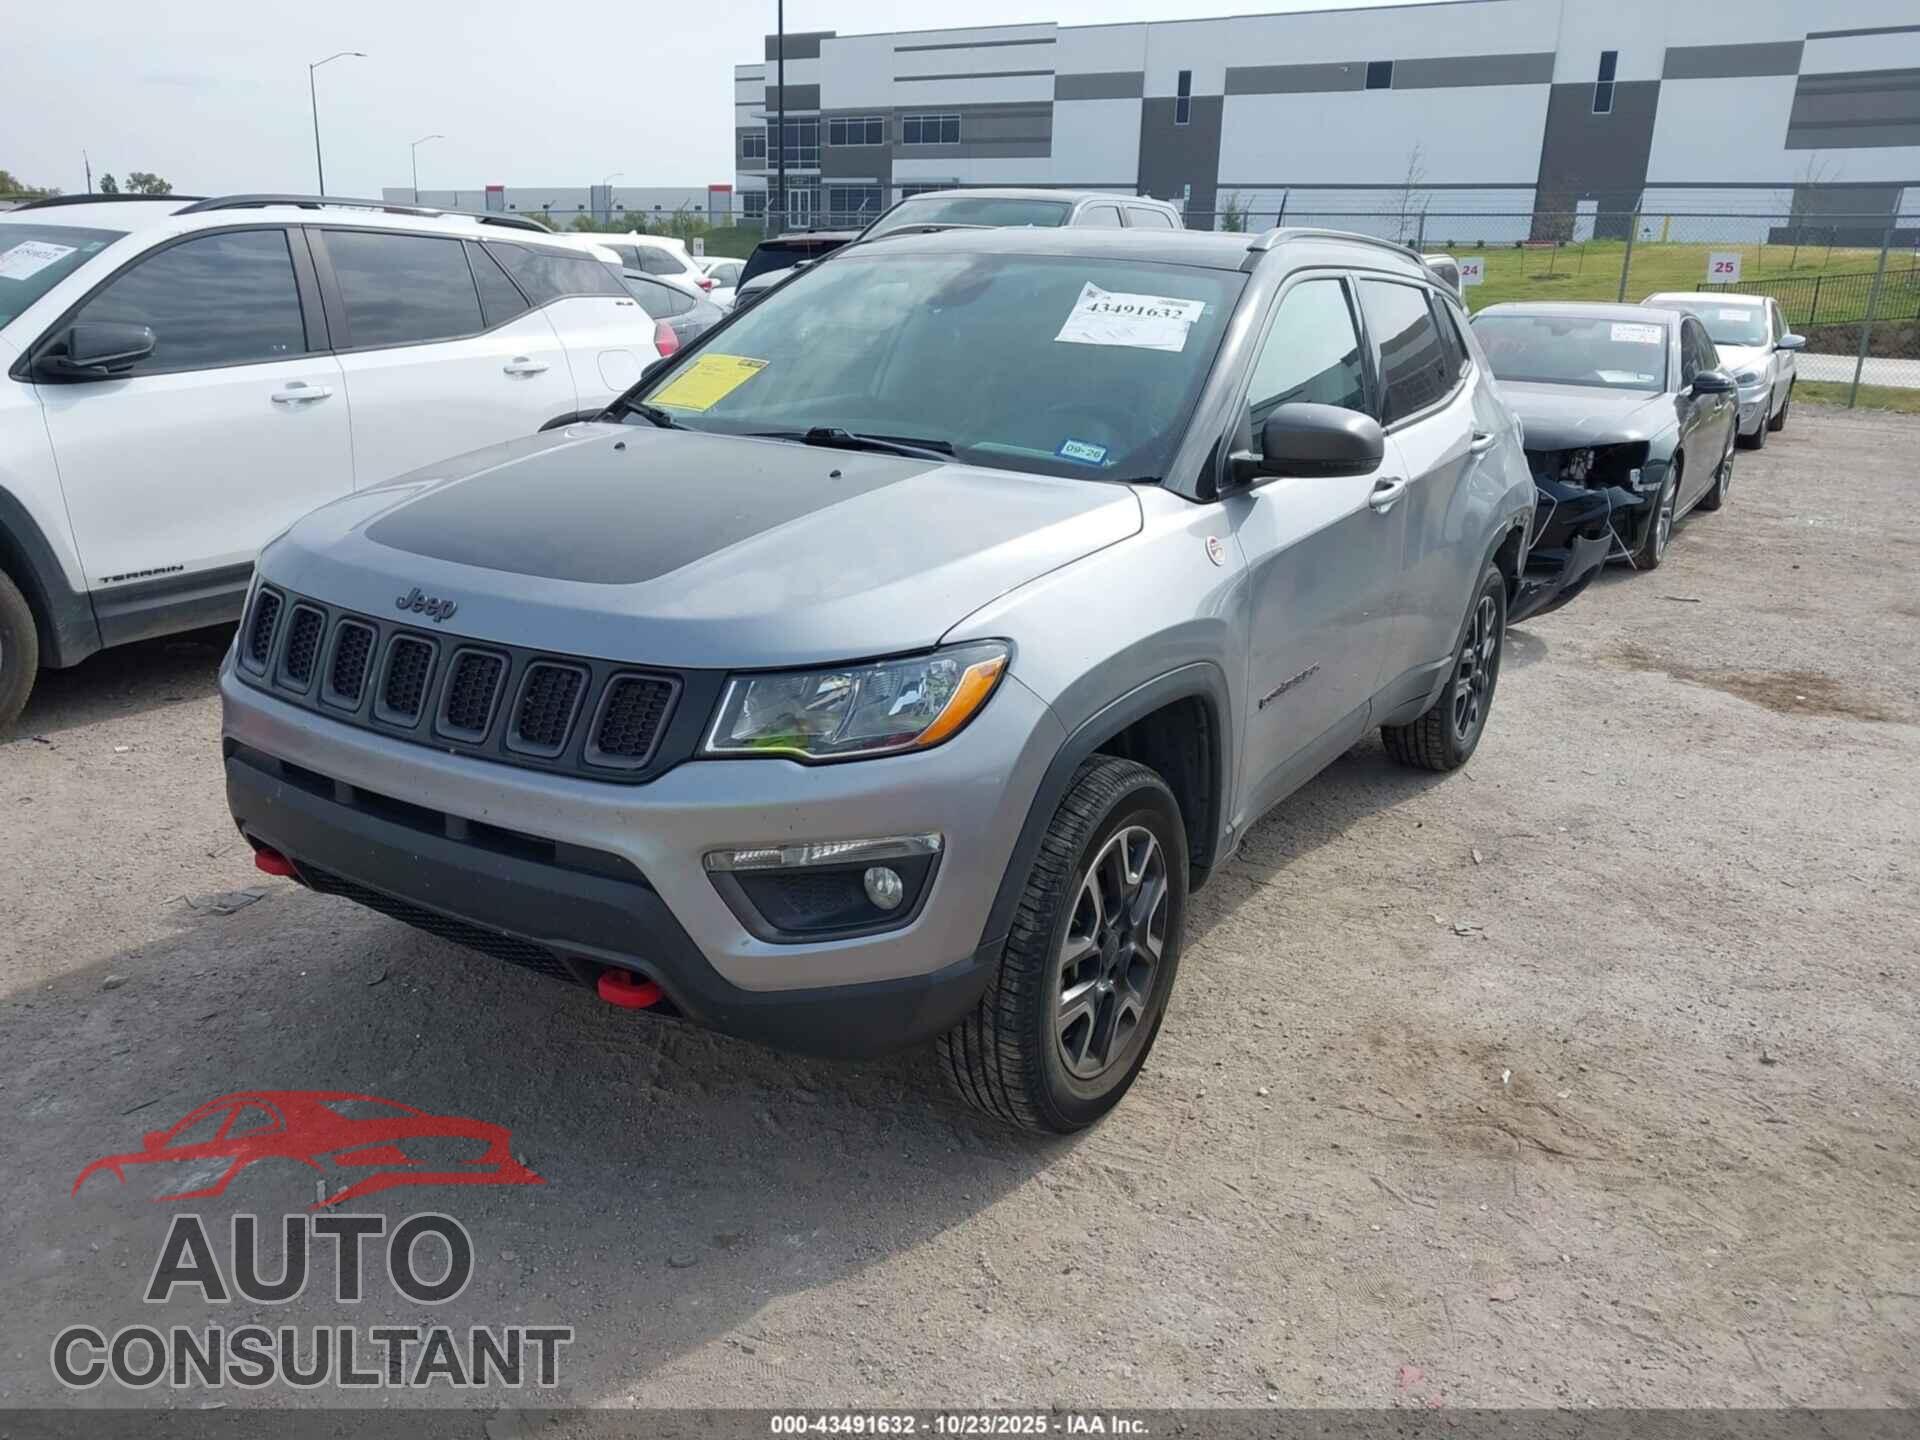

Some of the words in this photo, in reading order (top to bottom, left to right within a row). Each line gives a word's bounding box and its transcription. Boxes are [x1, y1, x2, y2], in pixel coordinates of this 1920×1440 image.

[1462, 264, 1479, 276] 24
[1714, 261, 1735, 273] 25
[1085, 302, 1184, 320] 43491632
[99, 564, 184, 583] TERRAIN
[395, 587, 458, 623] Jeep
